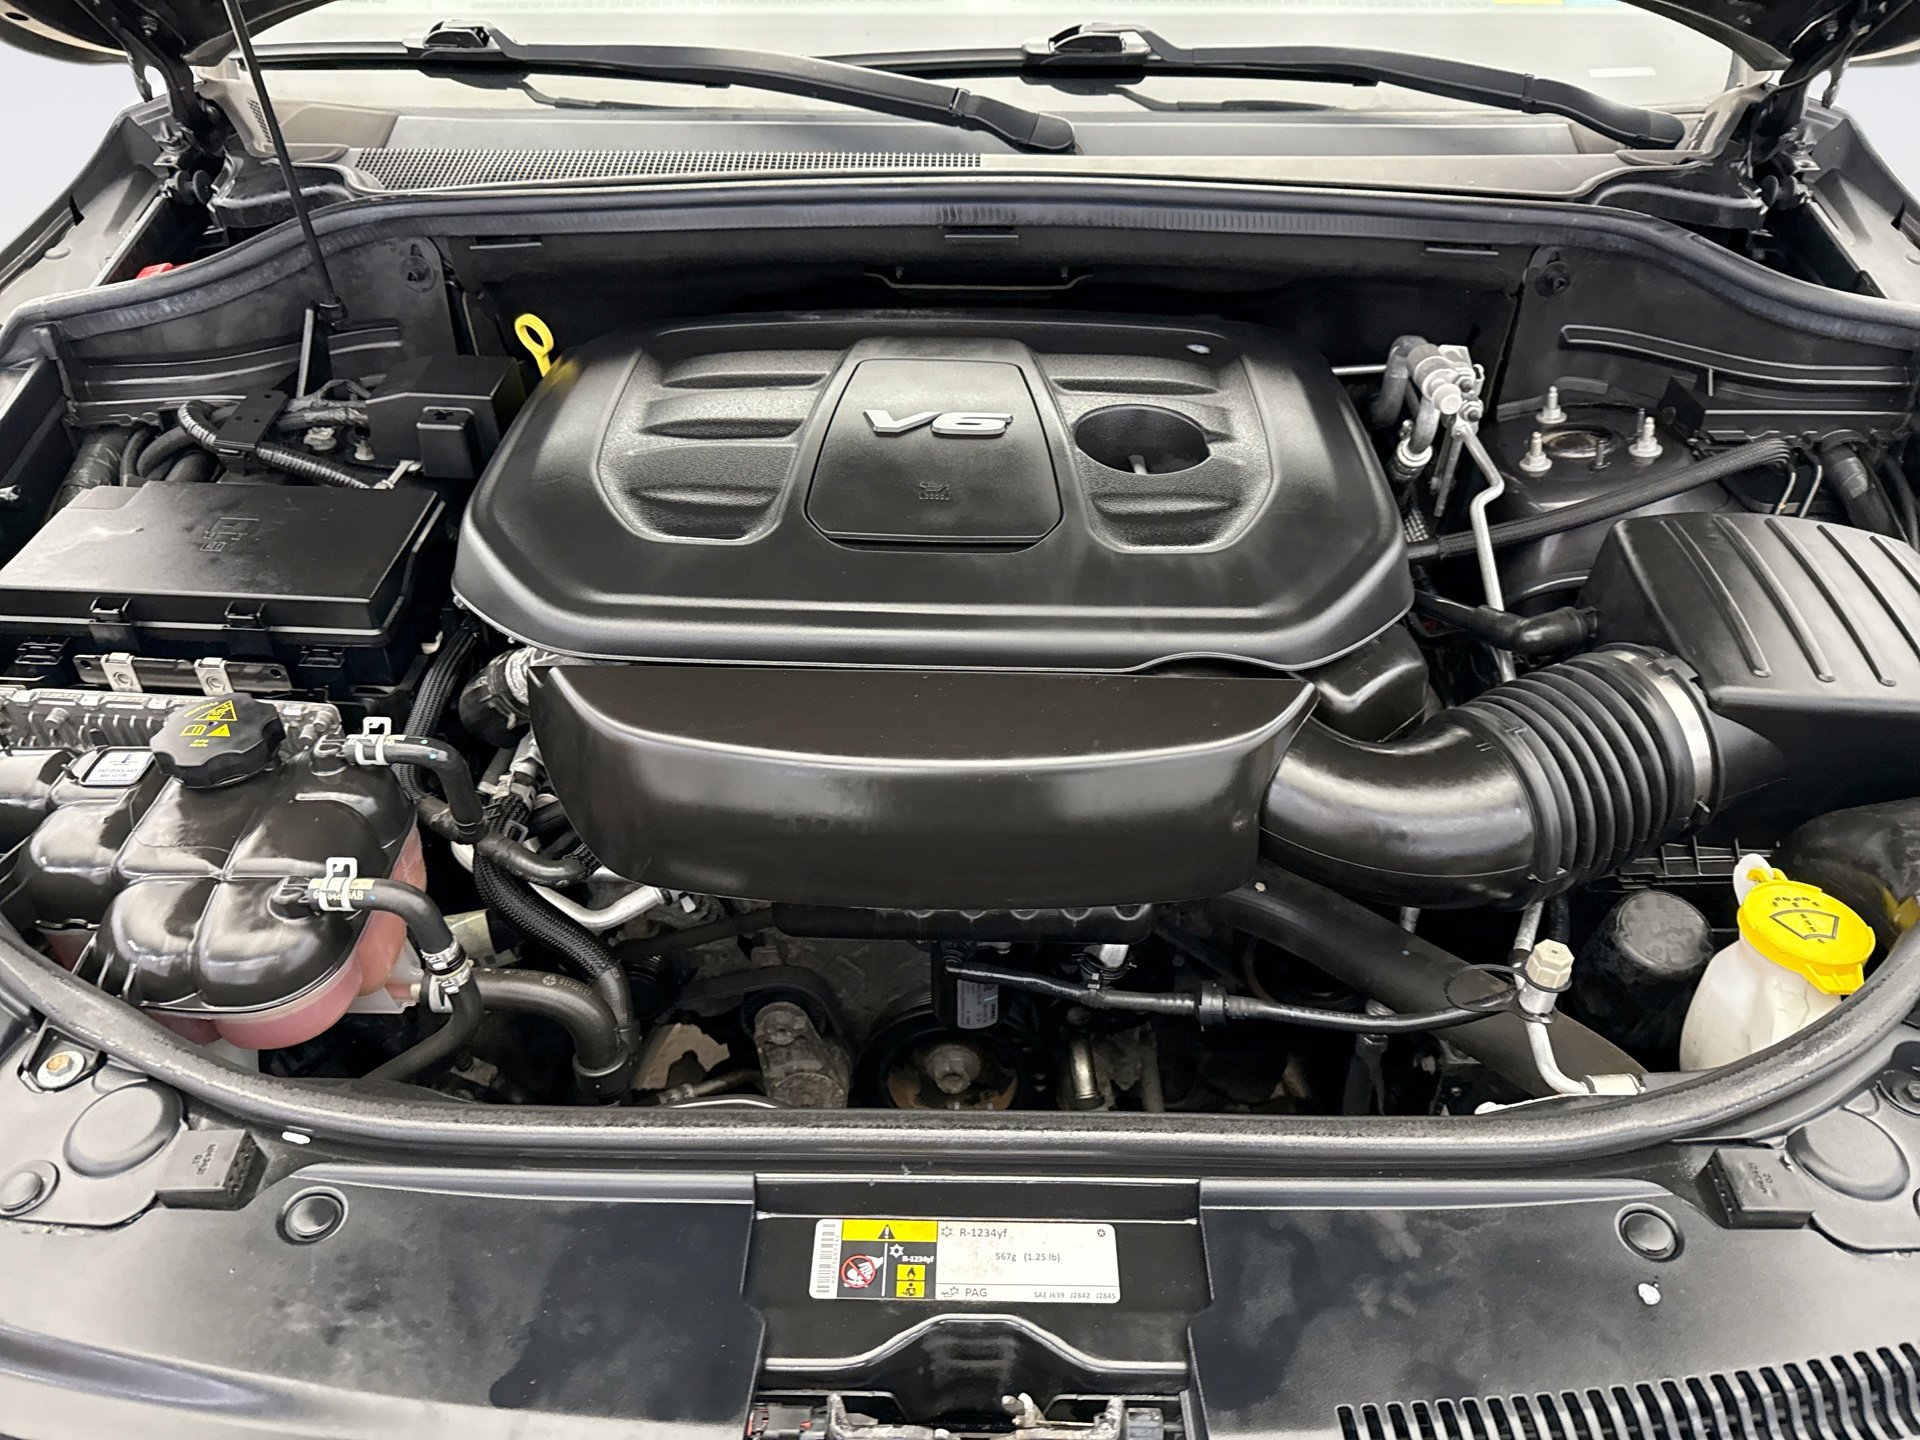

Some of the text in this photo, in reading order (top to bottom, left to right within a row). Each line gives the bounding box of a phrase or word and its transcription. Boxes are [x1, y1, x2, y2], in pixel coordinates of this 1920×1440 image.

[863, 409, 1013, 436] V6
[960, 1228, 1008, 1239] R-1234yf
[902, 1255, 935, 1264] R-1234yf
[995, 1252, 1061, 1263] 567g (1.25 lb)
[965, 1288, 988, 1297] PAG
